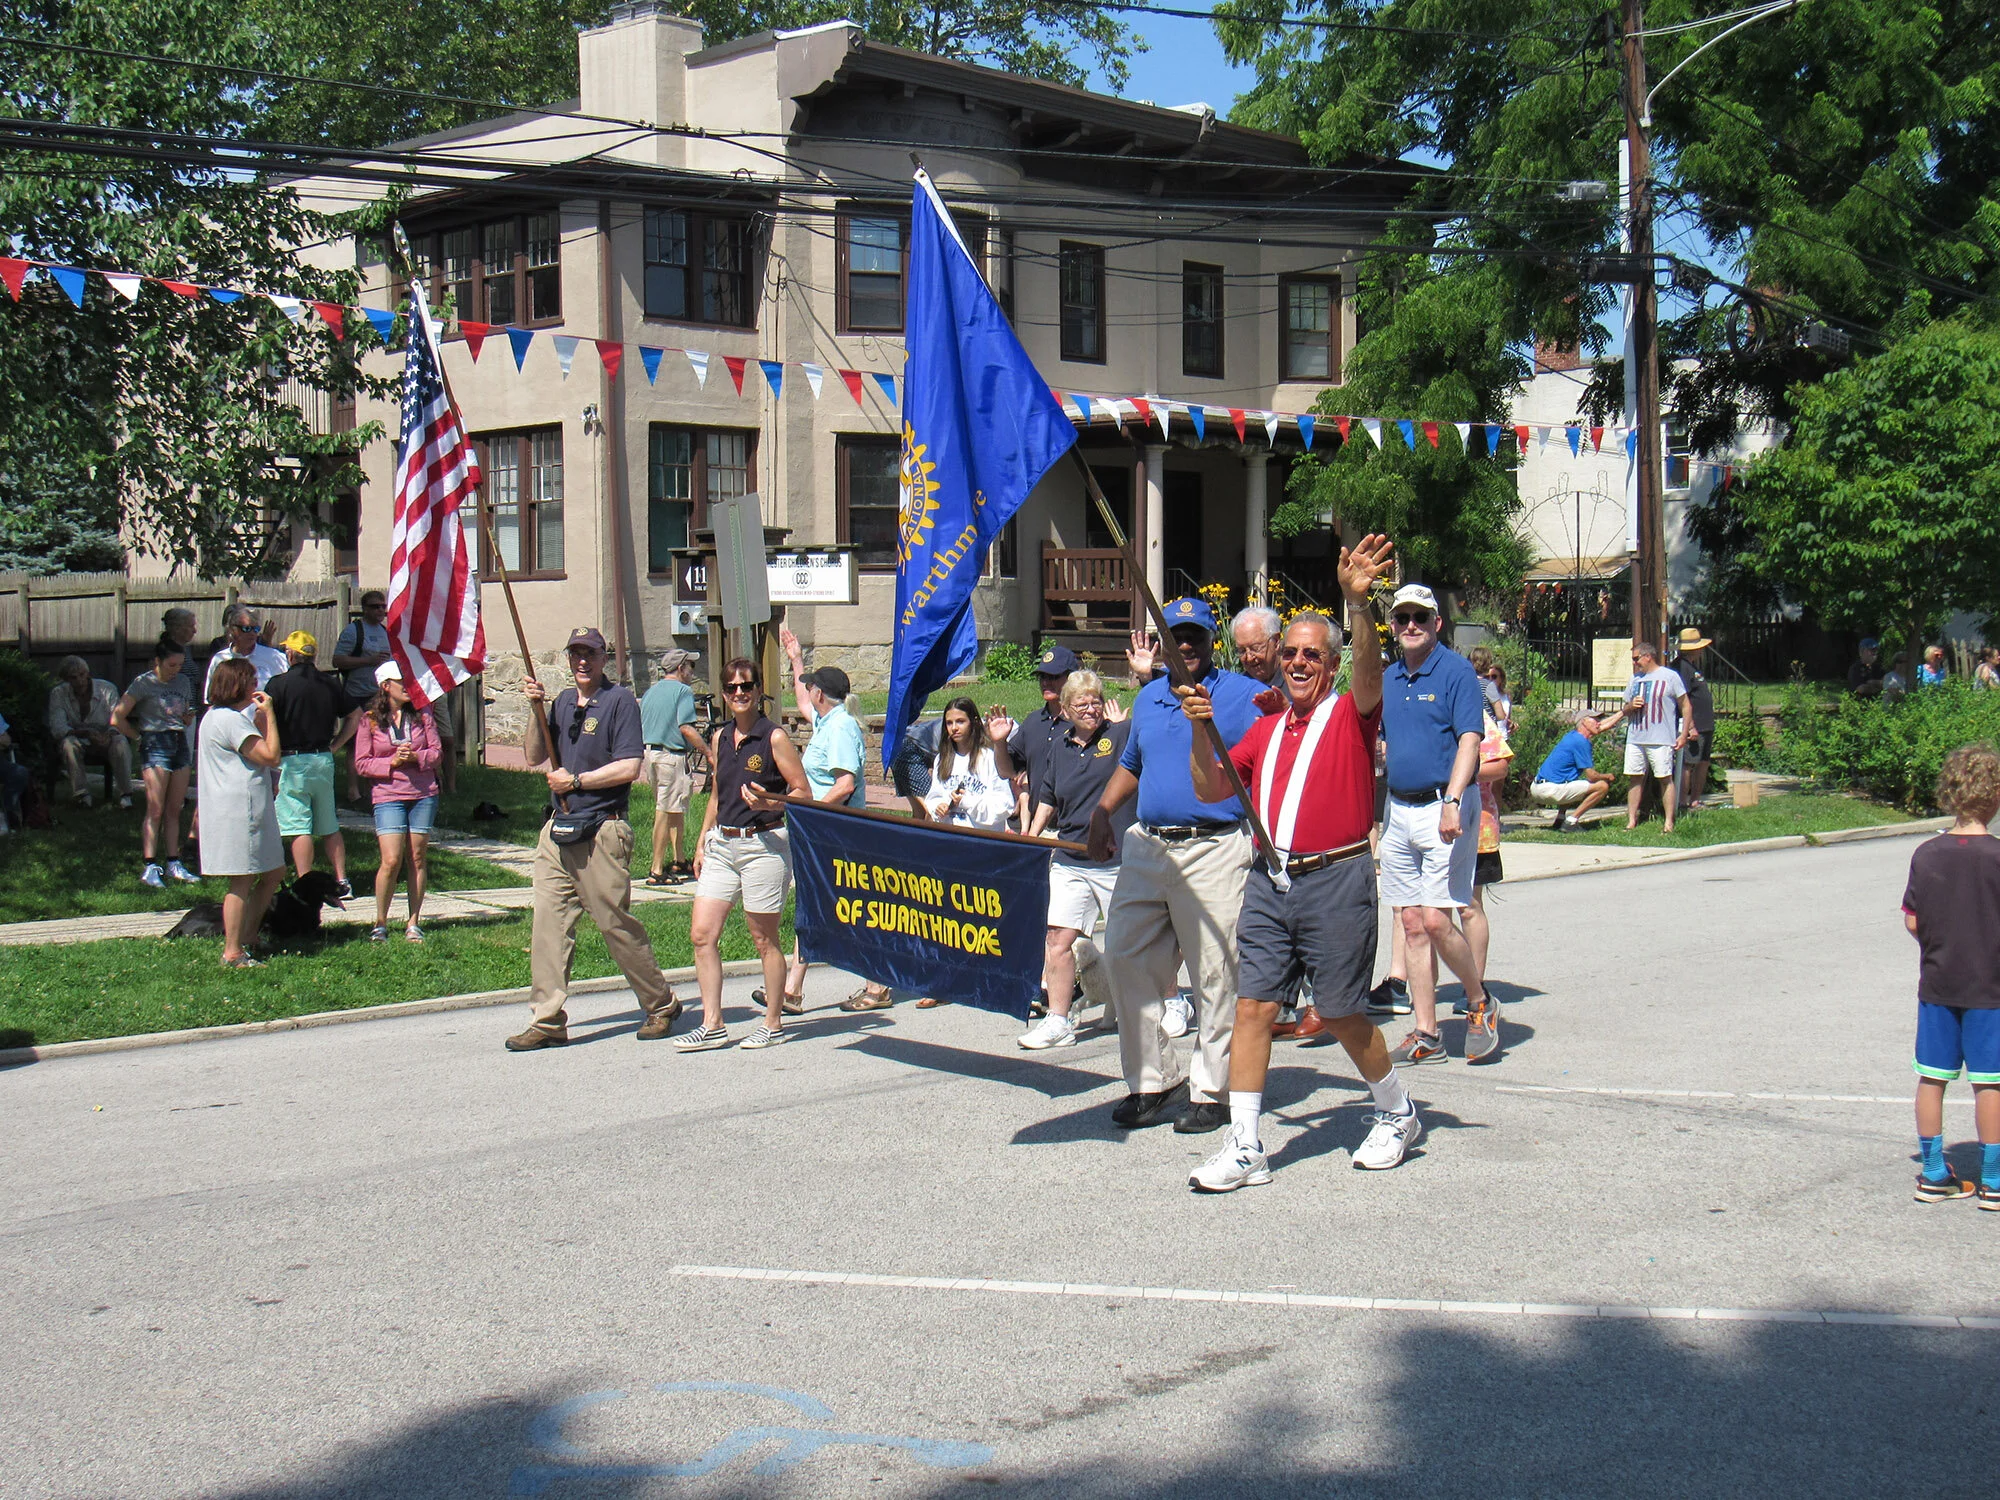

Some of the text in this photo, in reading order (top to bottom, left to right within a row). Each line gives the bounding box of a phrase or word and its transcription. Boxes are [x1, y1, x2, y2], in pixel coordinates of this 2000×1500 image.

[906, 466, 924, 536] ATIONAL
[767, 557, 788, 568] HESTER
[796, 572, 808, 584] CCC
[833, 859, 1003, 918] THE ROTARY CLUB
[835, 896, 1002, 956] OF SWARTHMORE
